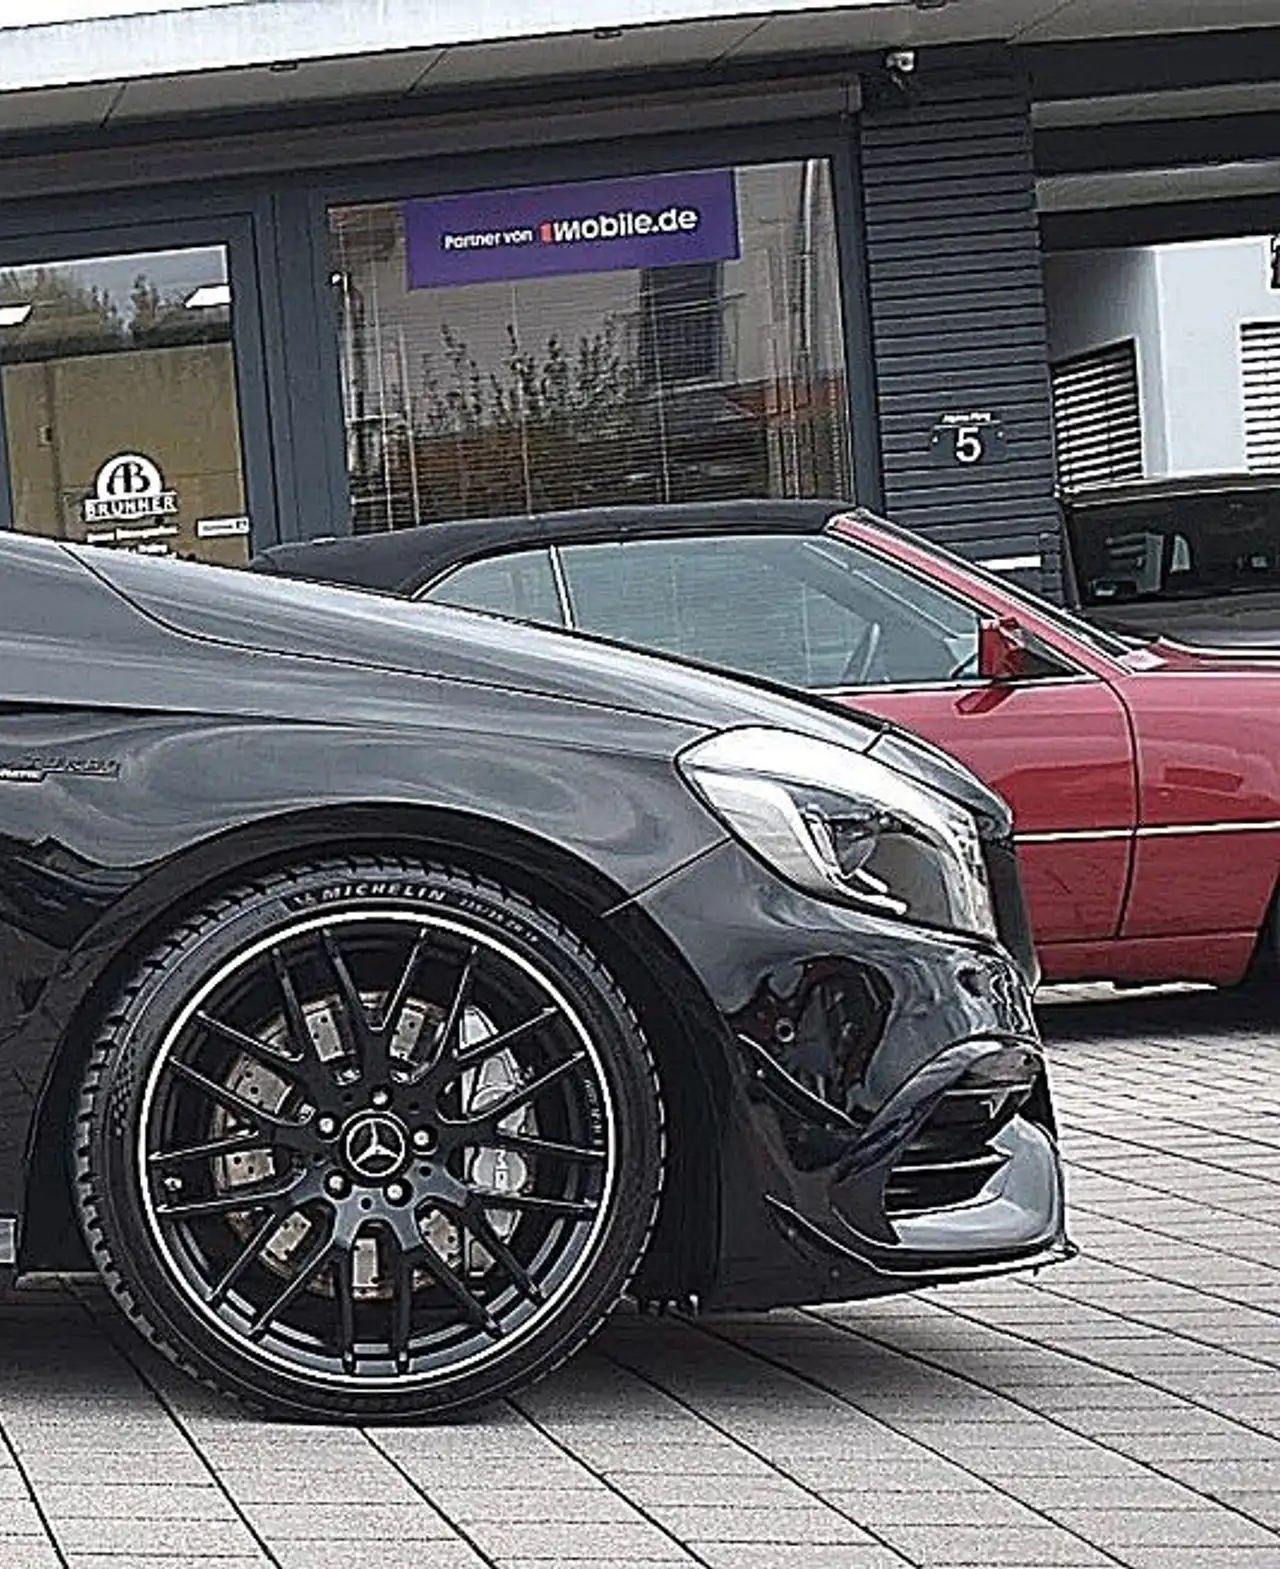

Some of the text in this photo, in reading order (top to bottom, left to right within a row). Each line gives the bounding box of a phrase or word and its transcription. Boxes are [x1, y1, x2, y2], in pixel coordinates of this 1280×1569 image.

[444, 208, 698, 250] Partner von mobile.de
[956, 426, 981, 462] 5
[322, 883, 446, 901] MICHELIN
